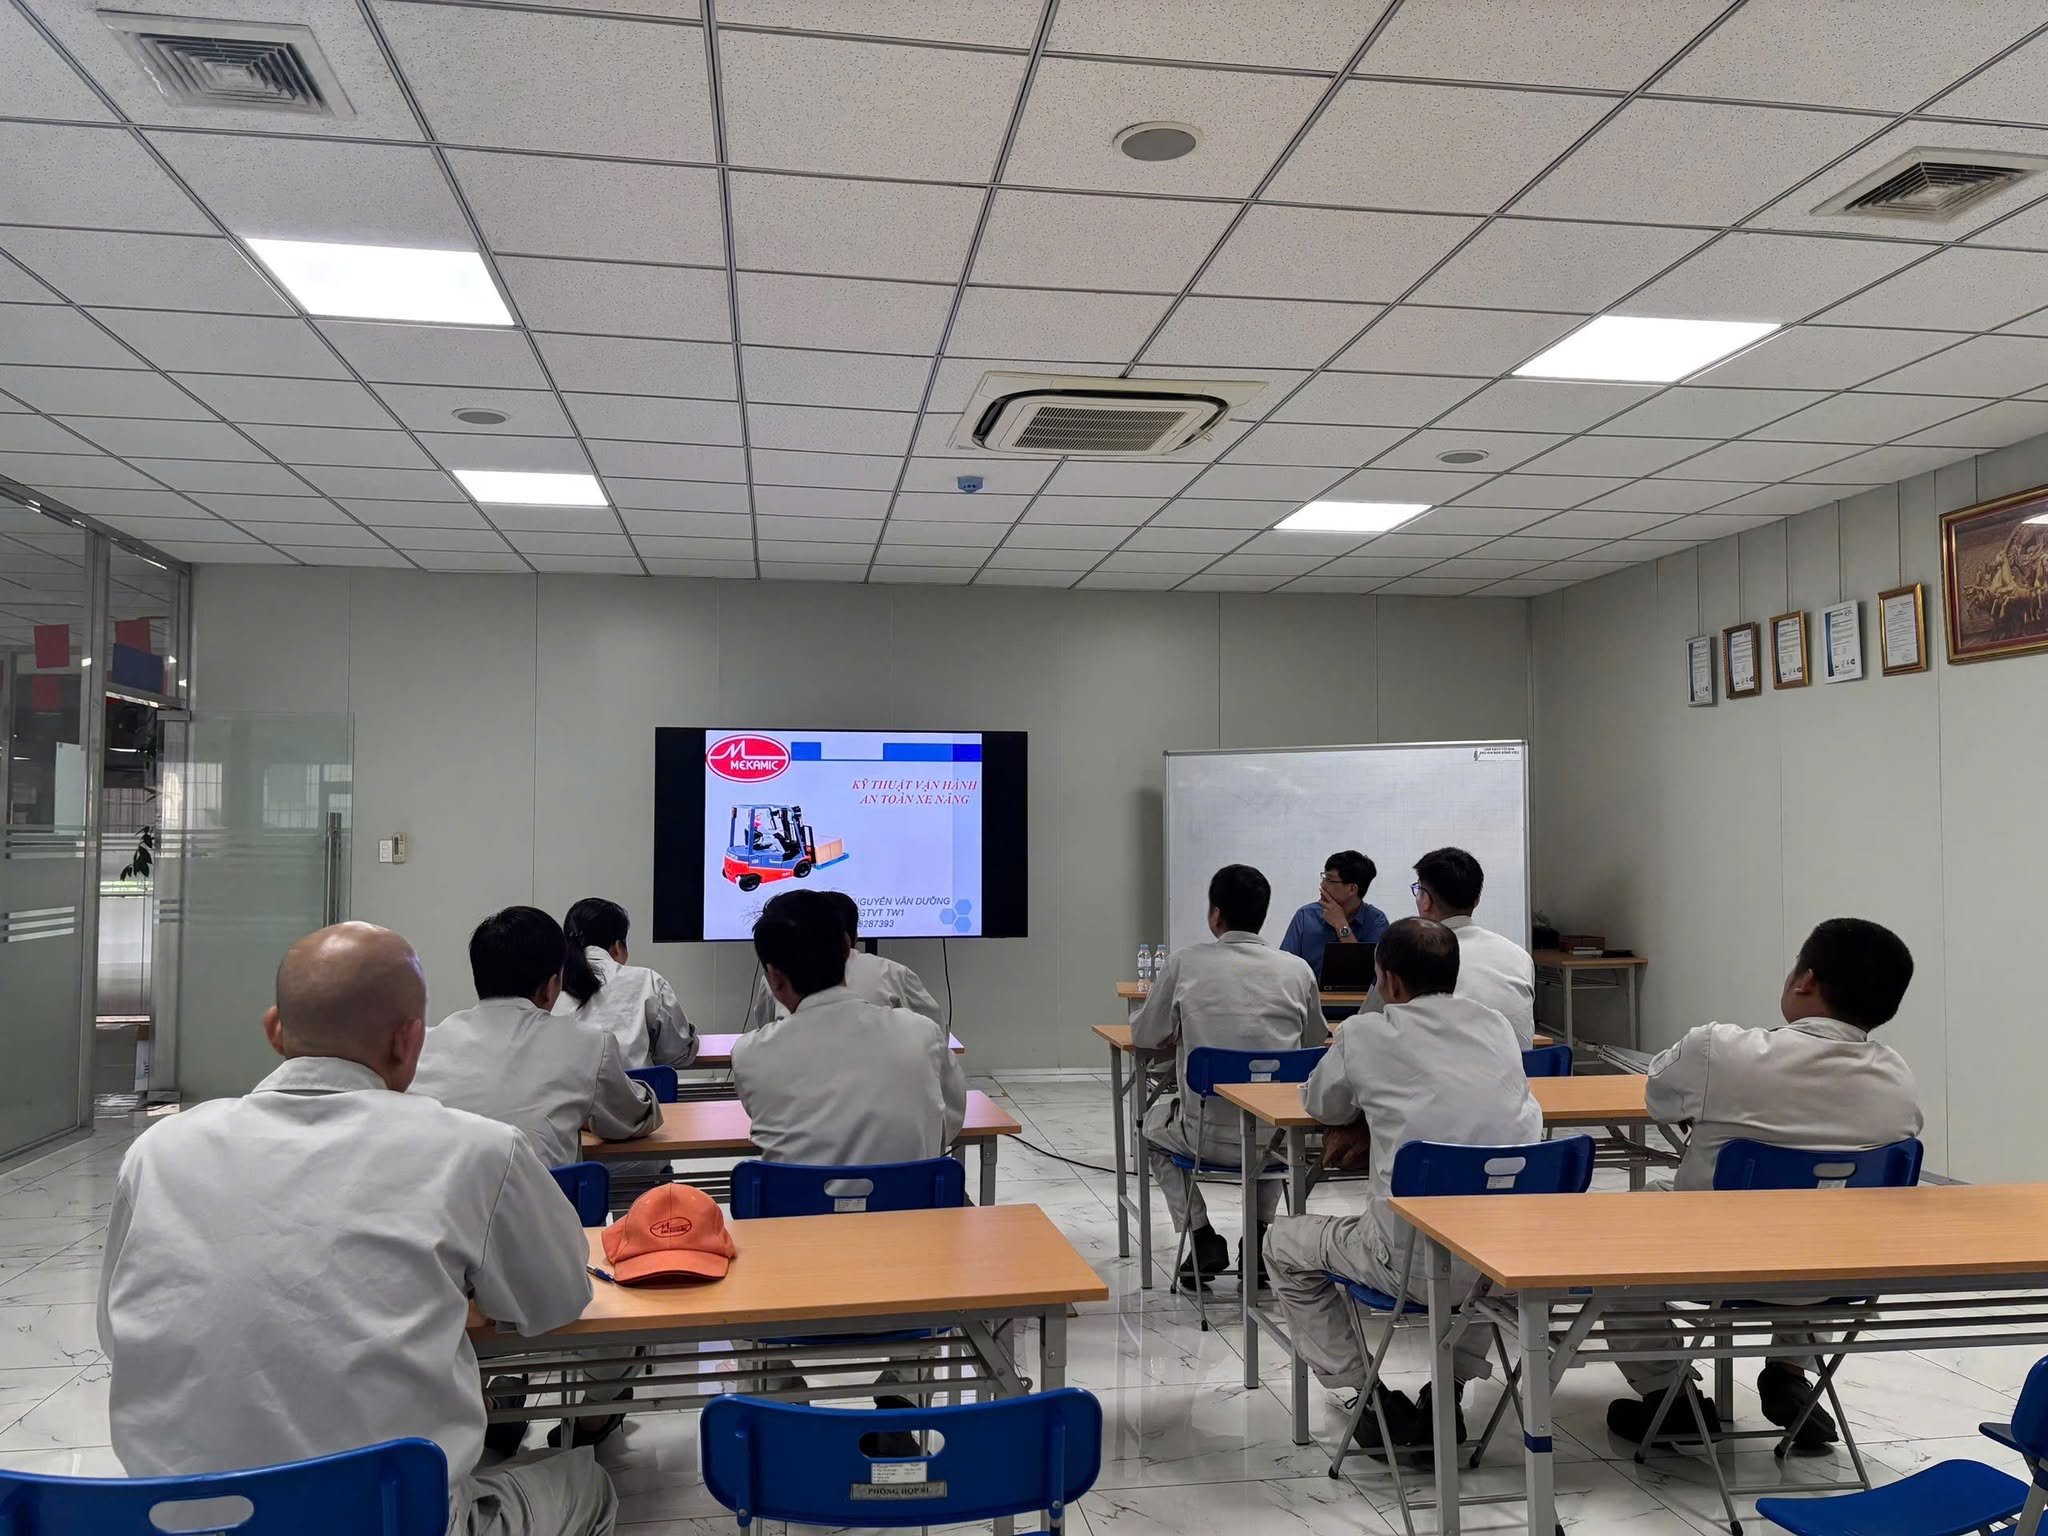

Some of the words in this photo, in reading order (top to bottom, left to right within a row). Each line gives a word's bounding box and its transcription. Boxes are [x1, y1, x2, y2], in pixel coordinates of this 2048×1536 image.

[730, 760, 779, 770] MEKAMIC
[852, 778, 869, 790] KỸ
[943, 777, 977, 790] HÀNH
[860, 794, 878, 804] AN
[881, 791, 914, 804] TOÀN
[915, 794, 933, 804] XE
[935, 792, 970, 804] NÂNG
[886, 908, 905, 917] TW1
